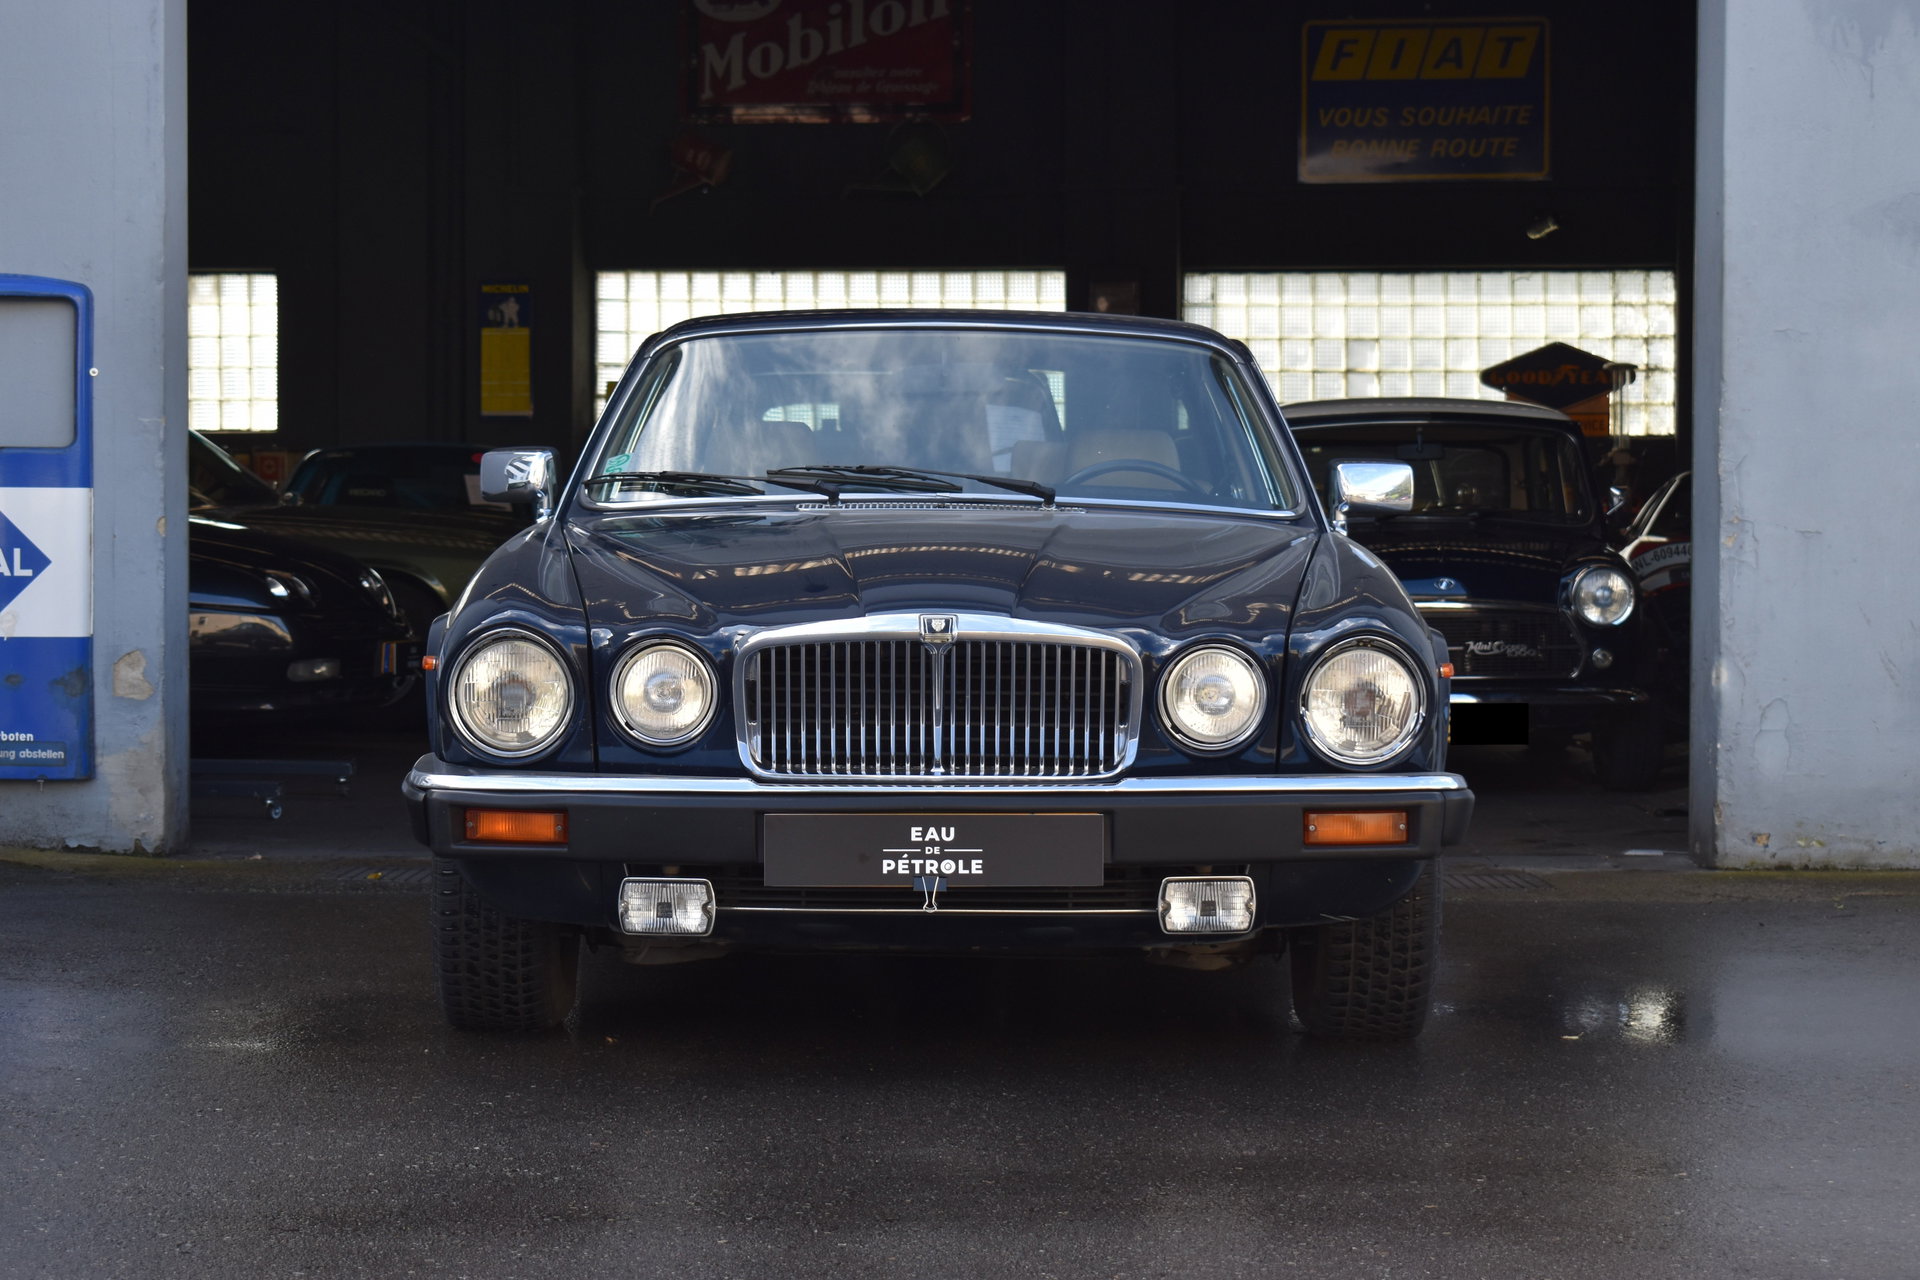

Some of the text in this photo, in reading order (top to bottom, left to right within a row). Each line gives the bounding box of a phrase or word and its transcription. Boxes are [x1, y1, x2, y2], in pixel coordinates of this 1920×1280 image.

[1327, 33, 1528, 73] FIAT
[1318, 104, 1535, 127] VOUS SOUHAITE
[1330, 137, 1521, 158] BONNE ROUTE
[1488, 364, 1610, 386] GOODYEA
[19, 748, 65, 759] abstellen
[910, 826, 956, 842] EAU
[925, 846, 941, 855] DE
[882, 853, 984, 875] PÉTROLE
